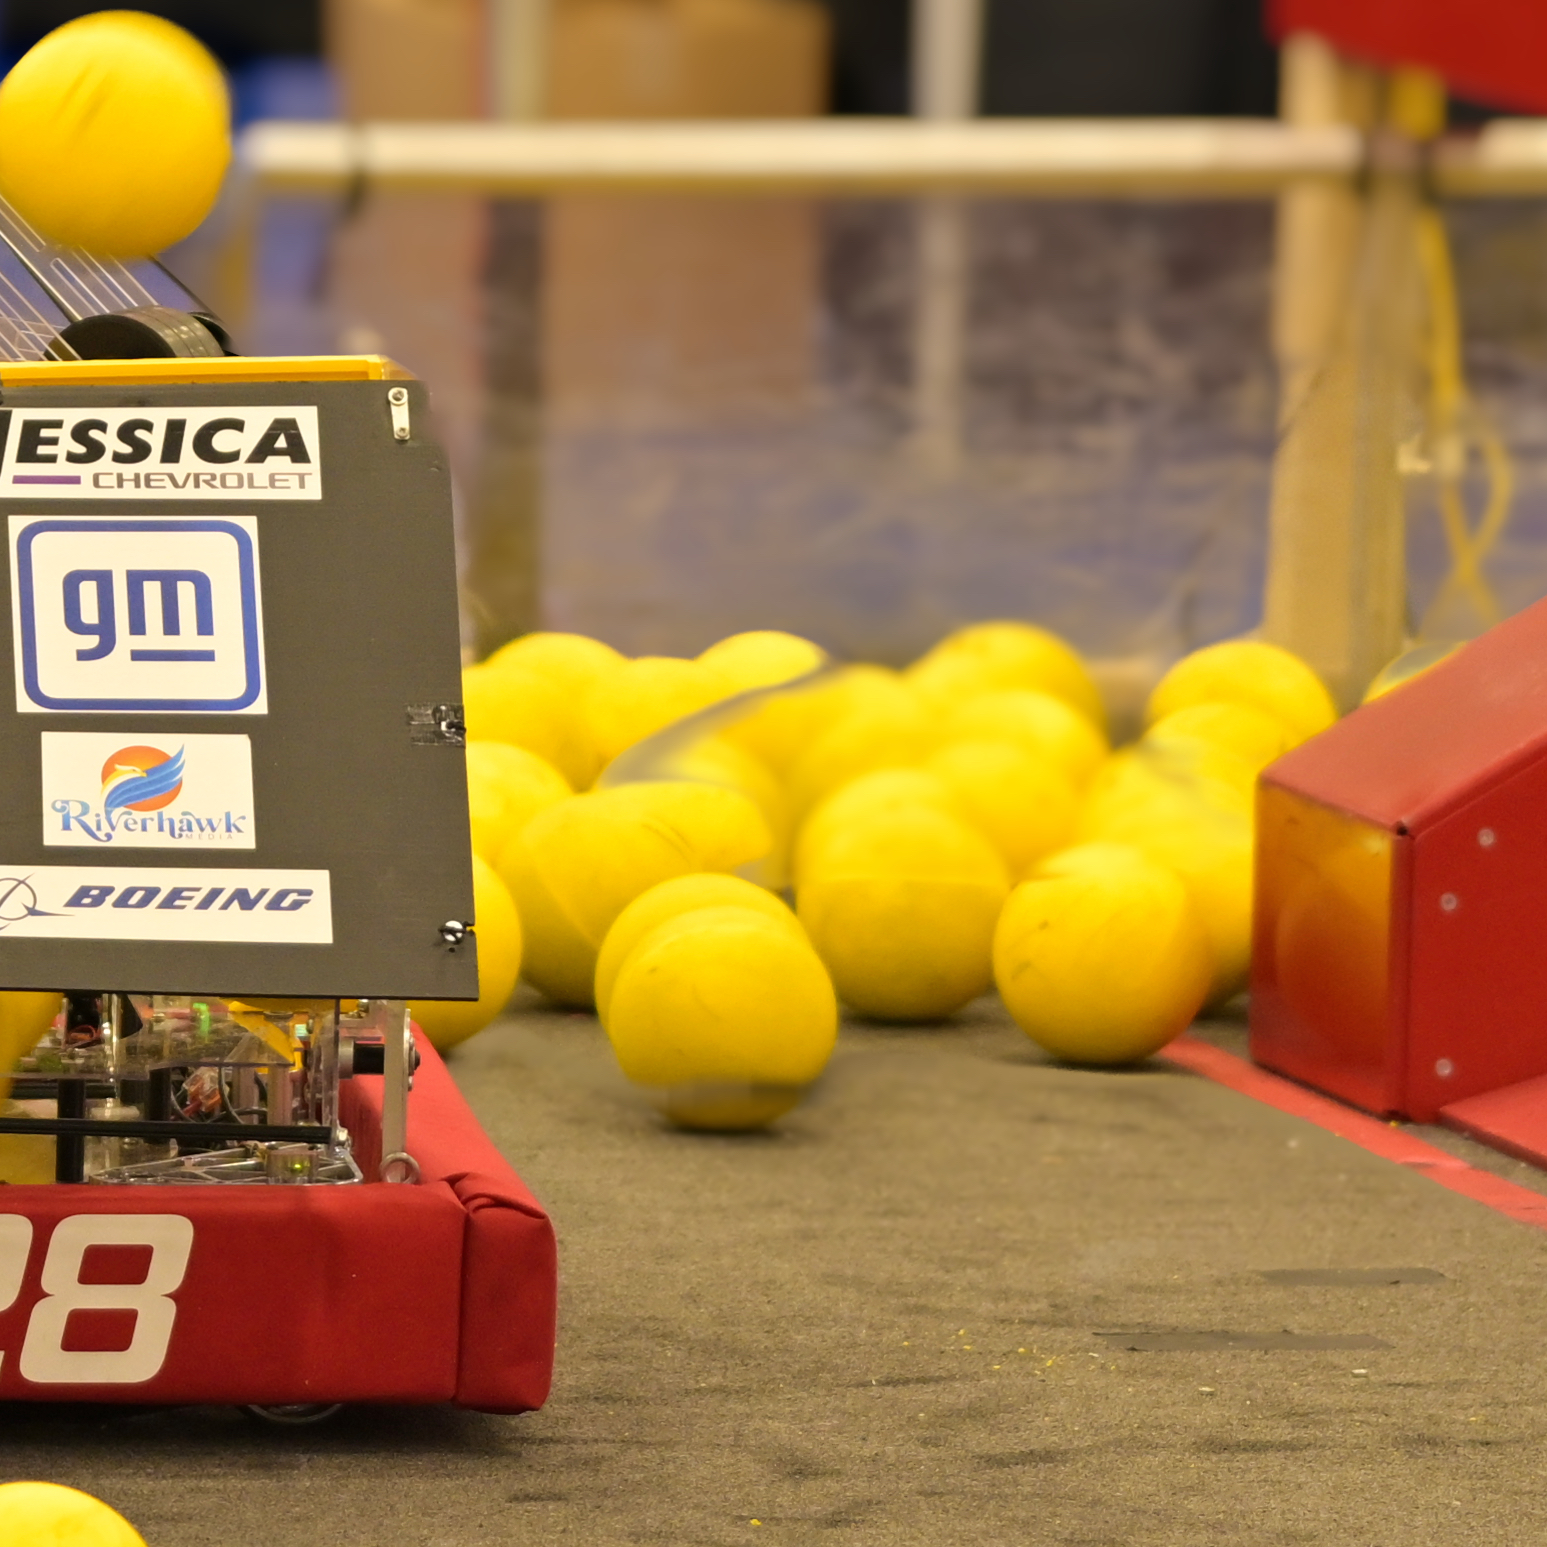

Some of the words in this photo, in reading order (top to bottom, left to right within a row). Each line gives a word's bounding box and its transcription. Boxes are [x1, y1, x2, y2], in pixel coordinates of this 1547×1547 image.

[92, 471, 313, 490] CHEVROLET
[62, 569, 216, 662] gm
[51, 799, 247, 843] Riverhawk
[63, 885, 314, 912] BOEING
